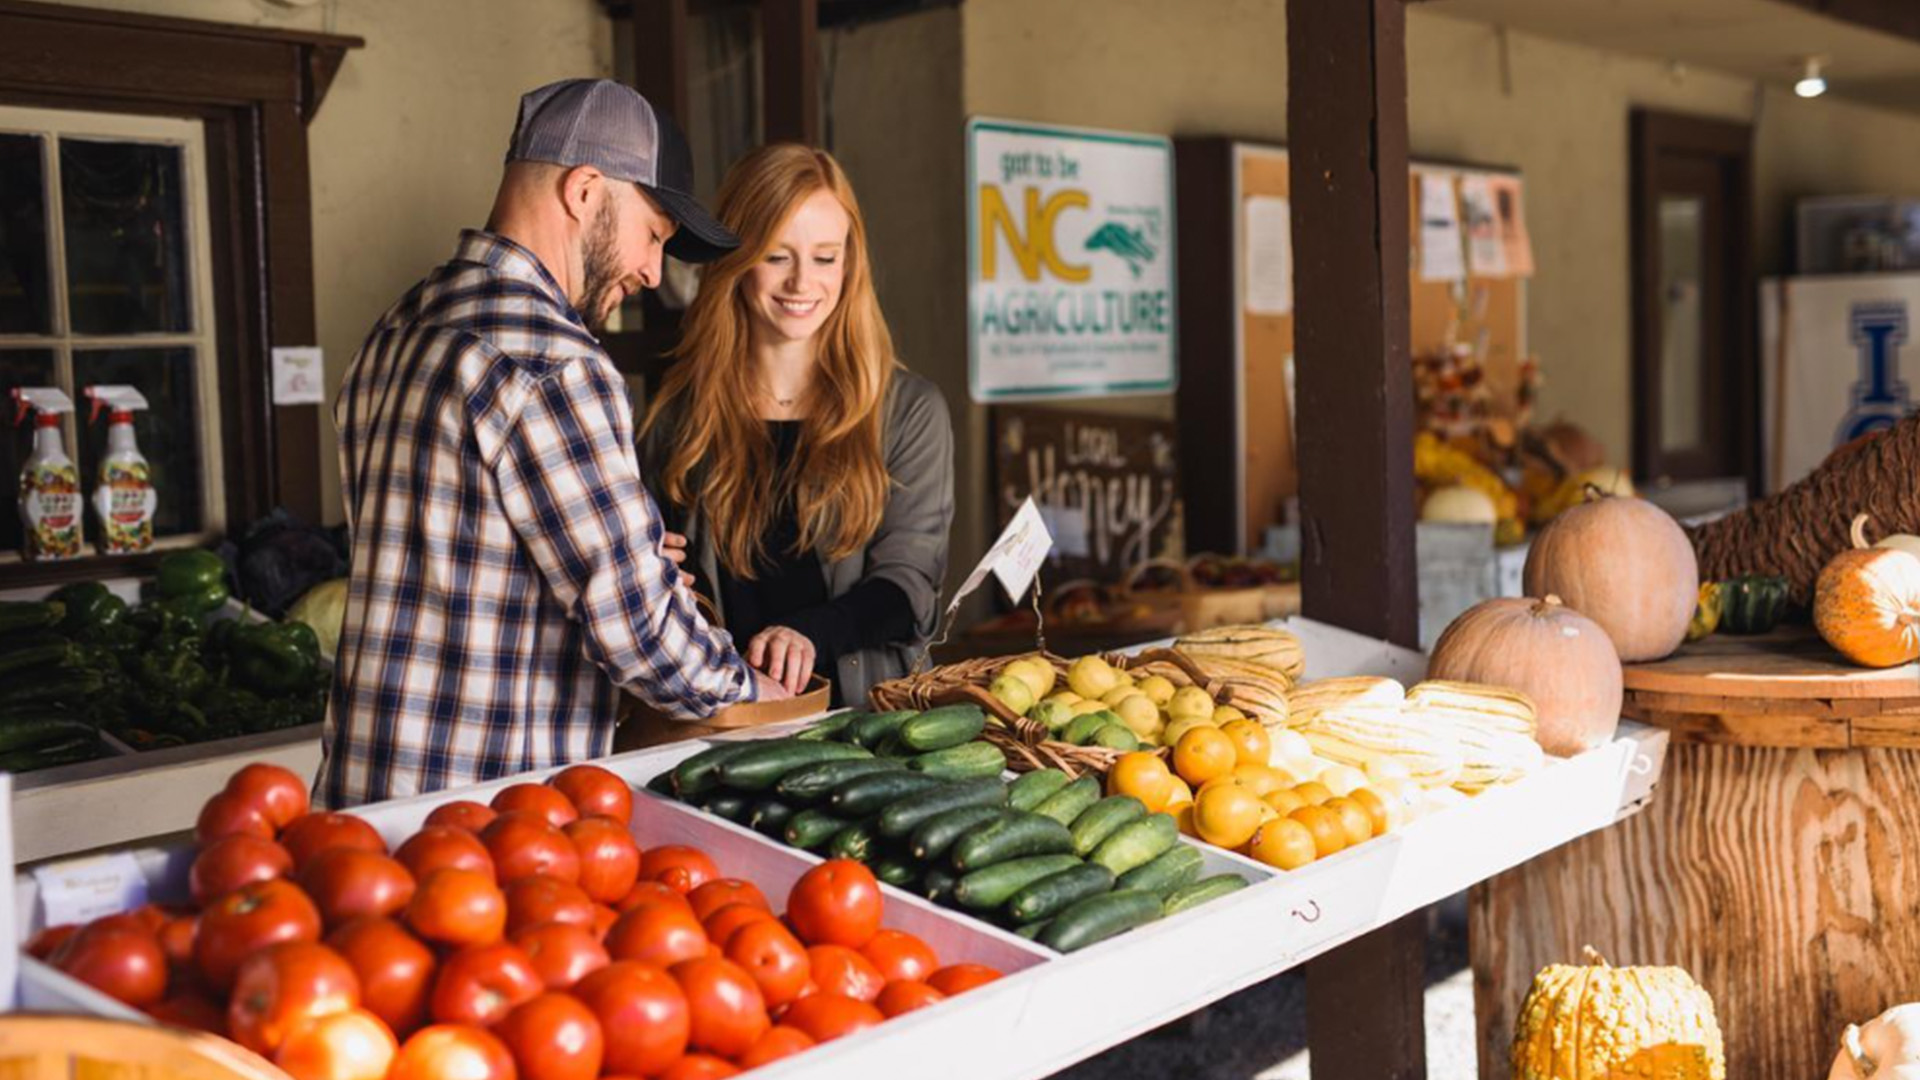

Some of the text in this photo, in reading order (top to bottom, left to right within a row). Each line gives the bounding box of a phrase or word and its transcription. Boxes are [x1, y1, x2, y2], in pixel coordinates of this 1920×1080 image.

[1001, 151, 1080, 182] got to be
[979, 182, 1092, 284] NC
[980, 289, 1168, 335] AGRICULTURE
[1008, 445, 1170, 569] Honey
